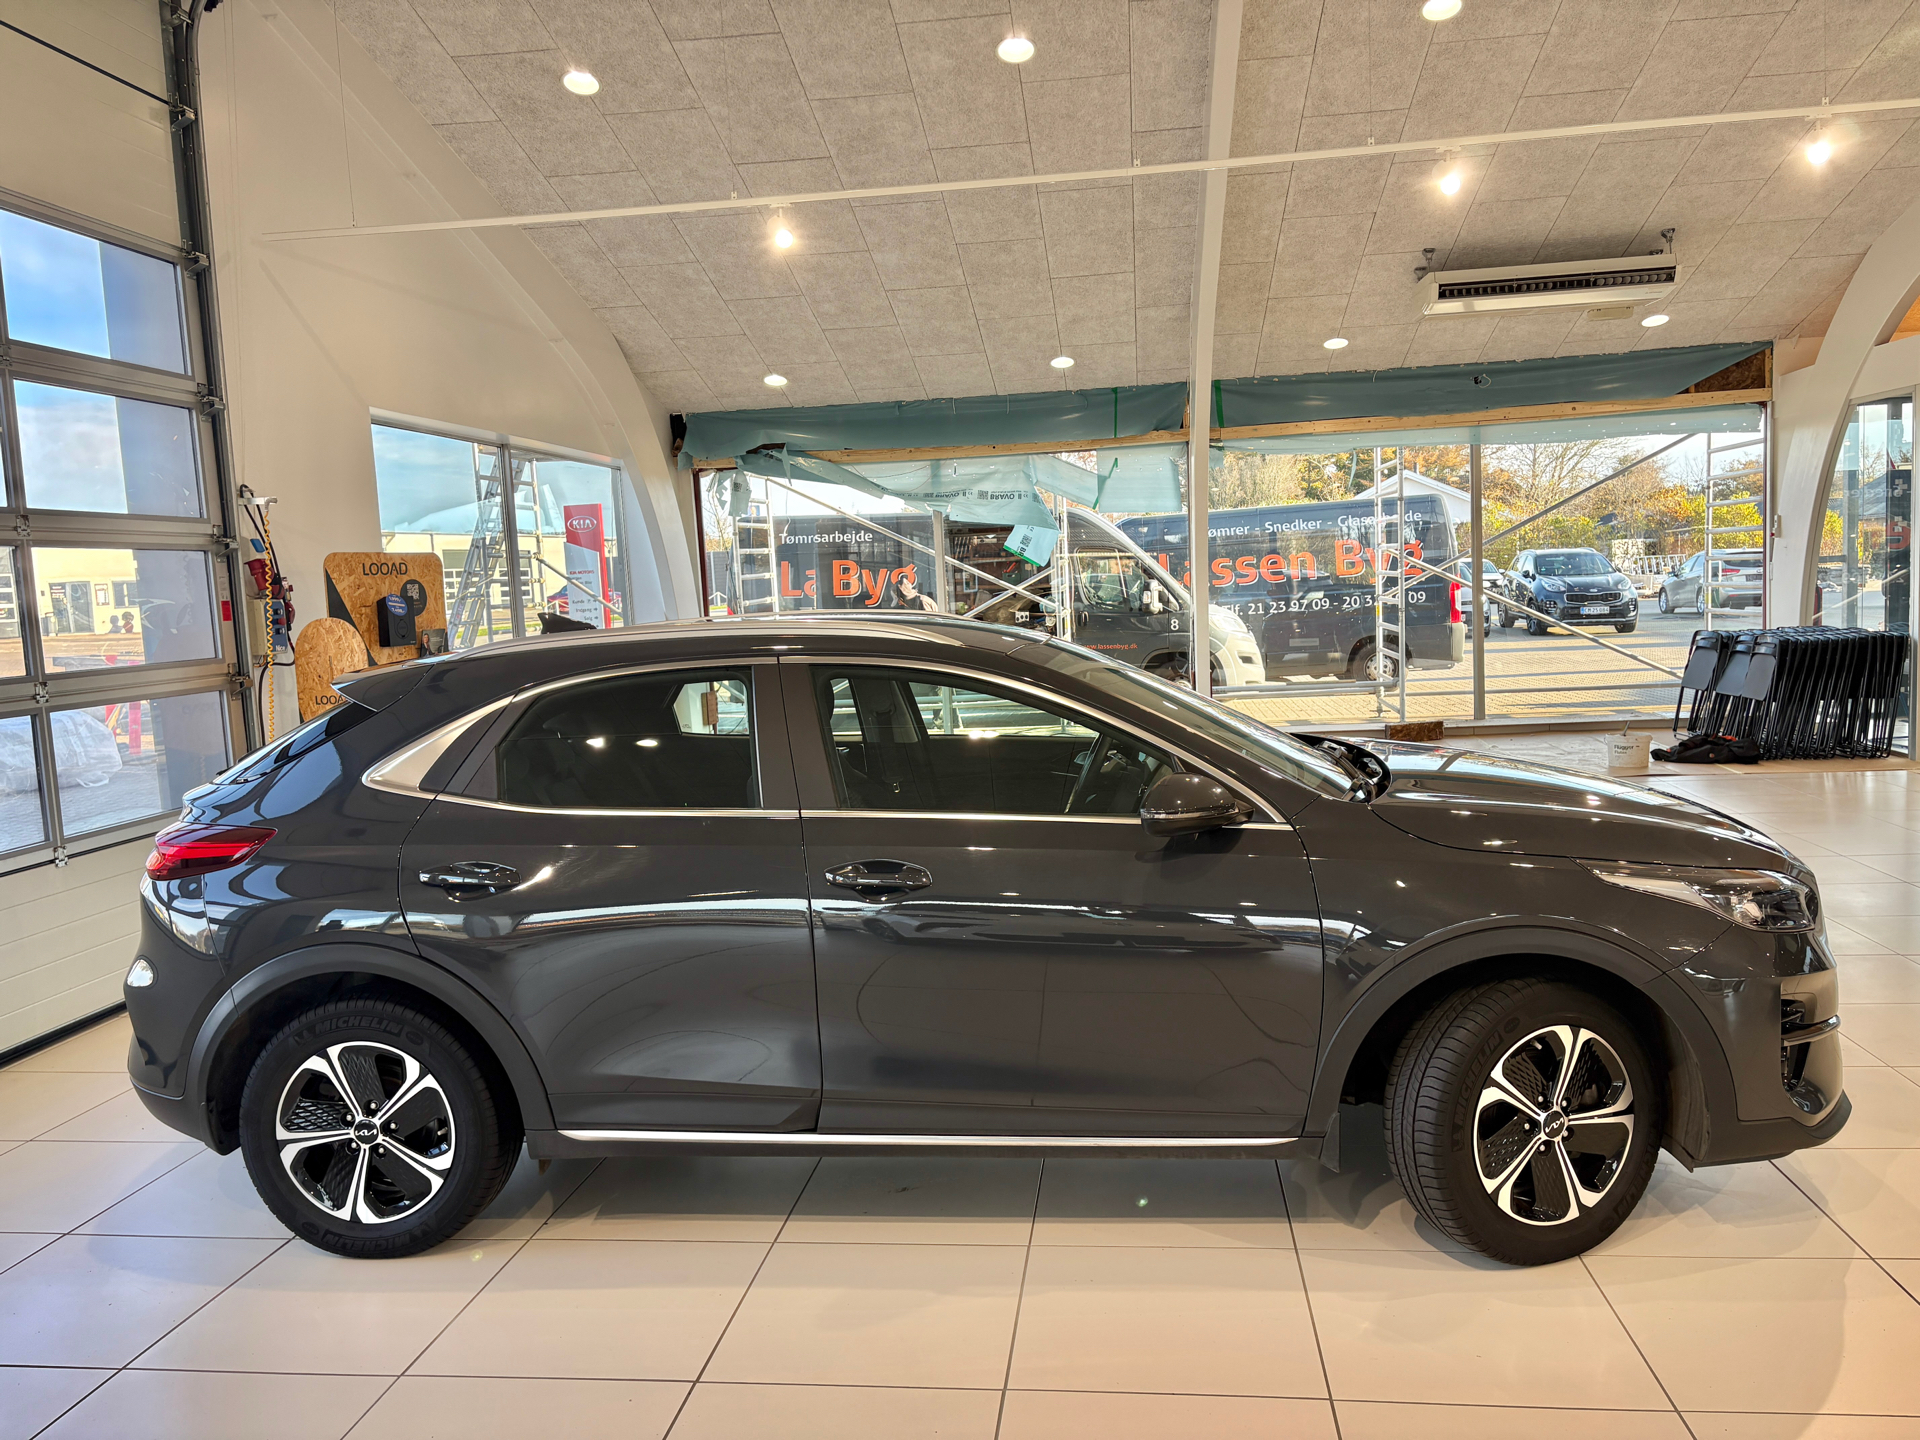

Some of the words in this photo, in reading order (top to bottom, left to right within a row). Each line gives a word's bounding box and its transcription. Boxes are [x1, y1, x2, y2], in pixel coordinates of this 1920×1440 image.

[572, 520, 592, 529] KIA
[1208, 524, 1250, 538] ømrer
[1264, 517, 1323, 533] Snedker
[362, 562, 408, 576] LOOAD
[1248, 603, 1265, 615] 21
[1269, 601, 1287, 613] 23
[1290, 600, 1309, 612] 97
[1312, 598, 1330, 610] 09
[1342, 596, 1360, 608] 20
[1408, 591, 1426, 603] 09
[1170, 618, 1179, 631] 8
[275, 644, 286, 652] Nice
[1084, 643, 1138, 651] ww.lassenbyg.dk
[315, 694, 344, 706] LOOA
[314, 1016, 402, 1036] MICHELIN
